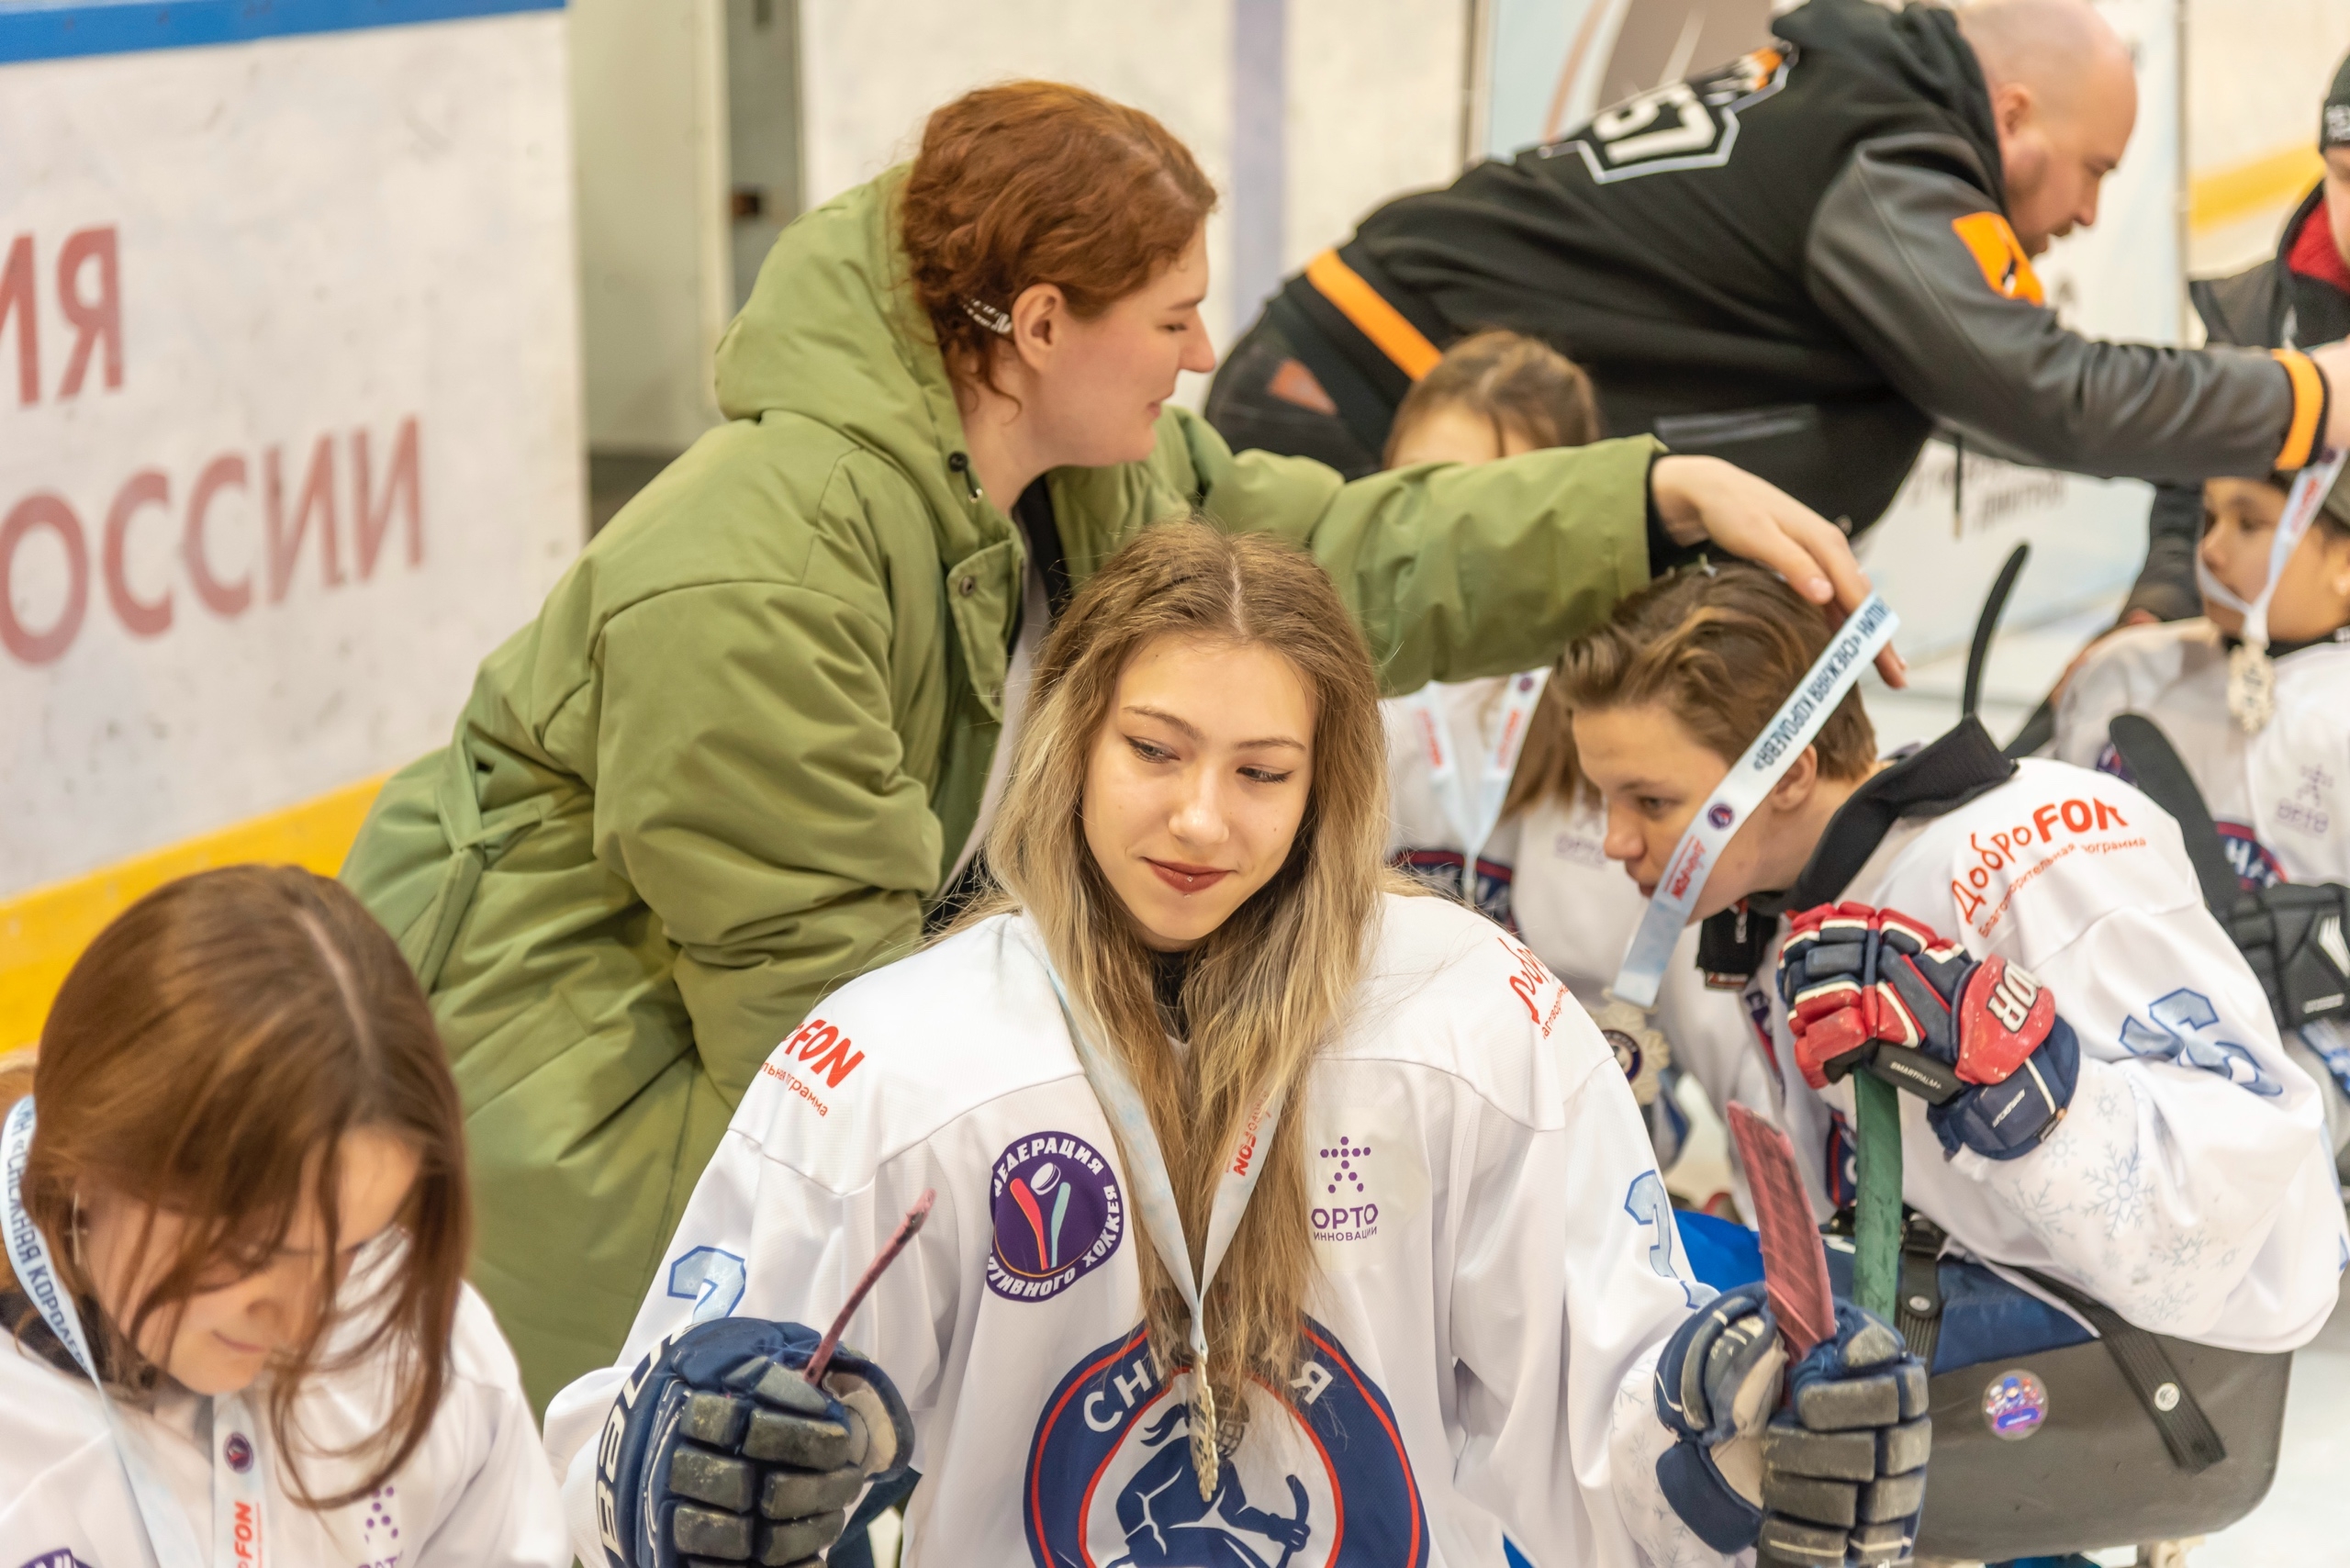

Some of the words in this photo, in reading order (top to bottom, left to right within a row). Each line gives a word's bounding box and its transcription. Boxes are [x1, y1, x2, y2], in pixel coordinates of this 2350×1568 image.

[0, 413, 423, 667] ОССИИ
[1081, 1184, 1120, 1268] ХОККЕЯ
[1311, 1203, 1379, 1229] ОРТО
[1313, 1226, 1378, 1242] ИННОВАЦИИ
[597, 1320, 700, 1562] BAU
